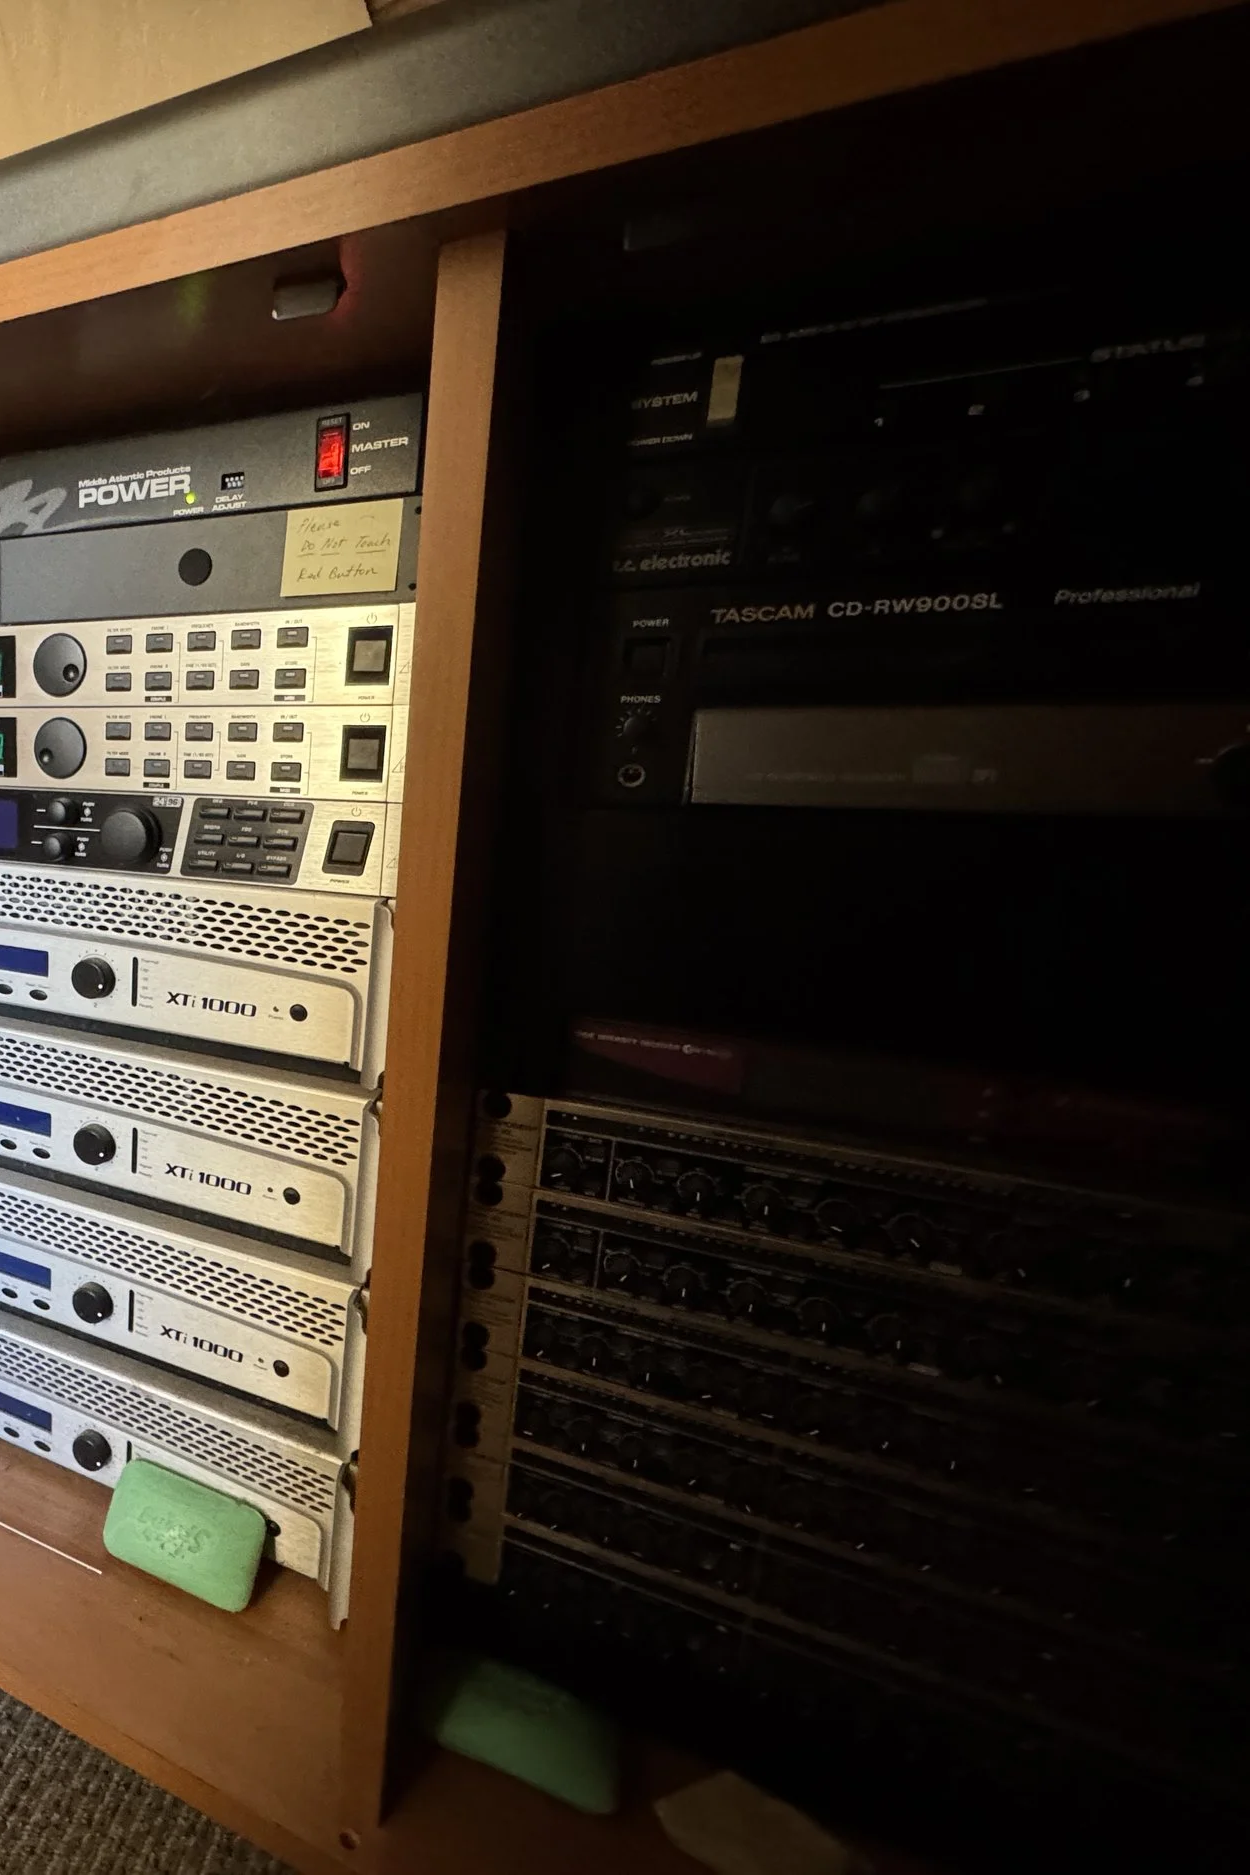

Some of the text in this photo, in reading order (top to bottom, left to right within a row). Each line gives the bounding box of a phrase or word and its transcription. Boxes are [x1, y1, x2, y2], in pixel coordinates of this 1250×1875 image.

[321, 417, 343, 426] RESET
[352, 421, 370, 431] ON
[351, 436, 409, 453] MASTER
[78, 465, 191, 488] Middle Atlantic Products
[350, 465, 372, 475] OFF
[78, 473, 191, 509] POWER
[215, 494, 244, 504] DELAY
[173, 506, 204, 516] POWER
[212, 501, 247, 512] ADJUST
[297, 517, 341, 534] Please
[300, 539, 316, 552] Do
[321, 538, 349, 551] Not
[639, 548, 733, 572] electronic
[296, 567, 379, 583] Red Button
[1053, 580, 1202, 606] Professional
[710, 592, 1004, 625] TASCAM CD-RW900SL
[632, 618, 670, 628] POWER
[620, 694, 661, 704] PHONES
[166, 991, 257, 1018] XTi 1000
[164, 1162, 252, 1196] XTi 1000
[159, 1324, 244, 1364] XTi 1000
